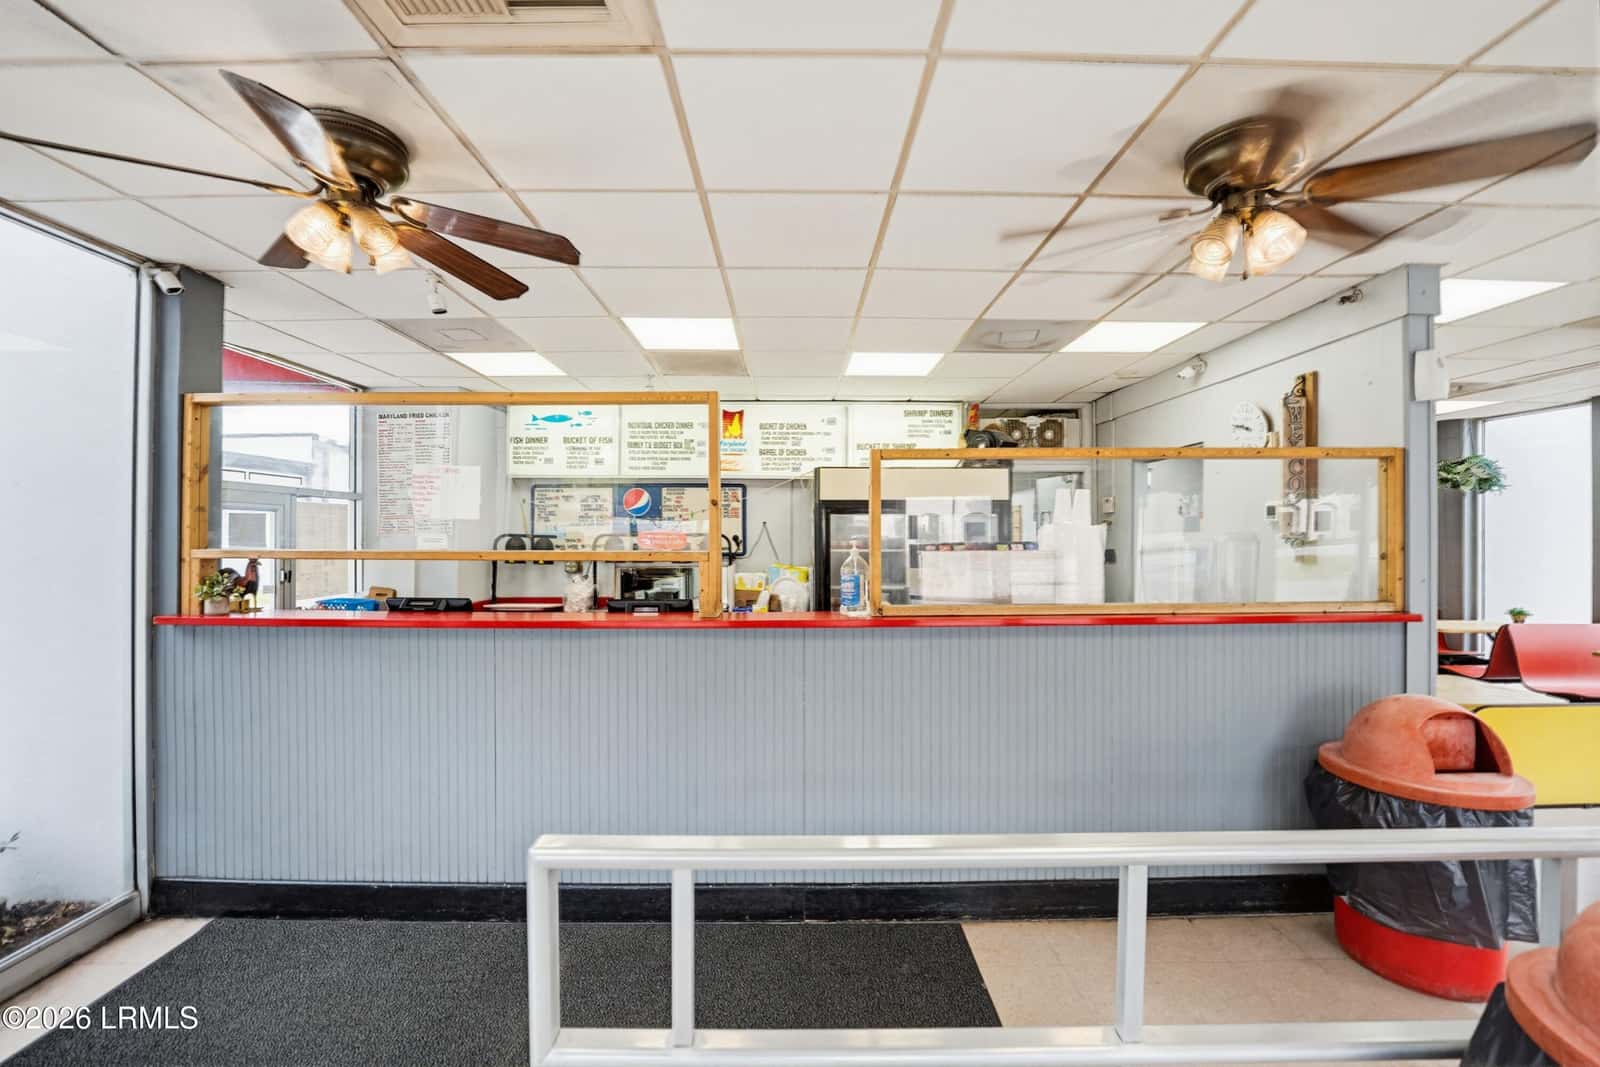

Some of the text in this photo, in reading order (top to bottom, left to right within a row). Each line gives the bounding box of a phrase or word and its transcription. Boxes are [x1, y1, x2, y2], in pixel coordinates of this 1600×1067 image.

[929, 409, 953, 418] DINNER
[759, 422, 807, 430] BUCKET OF CHICKEN
[524, 436, 548, 444] DINNER
[562, 436, 614, 444] BUCKET OF FISH
